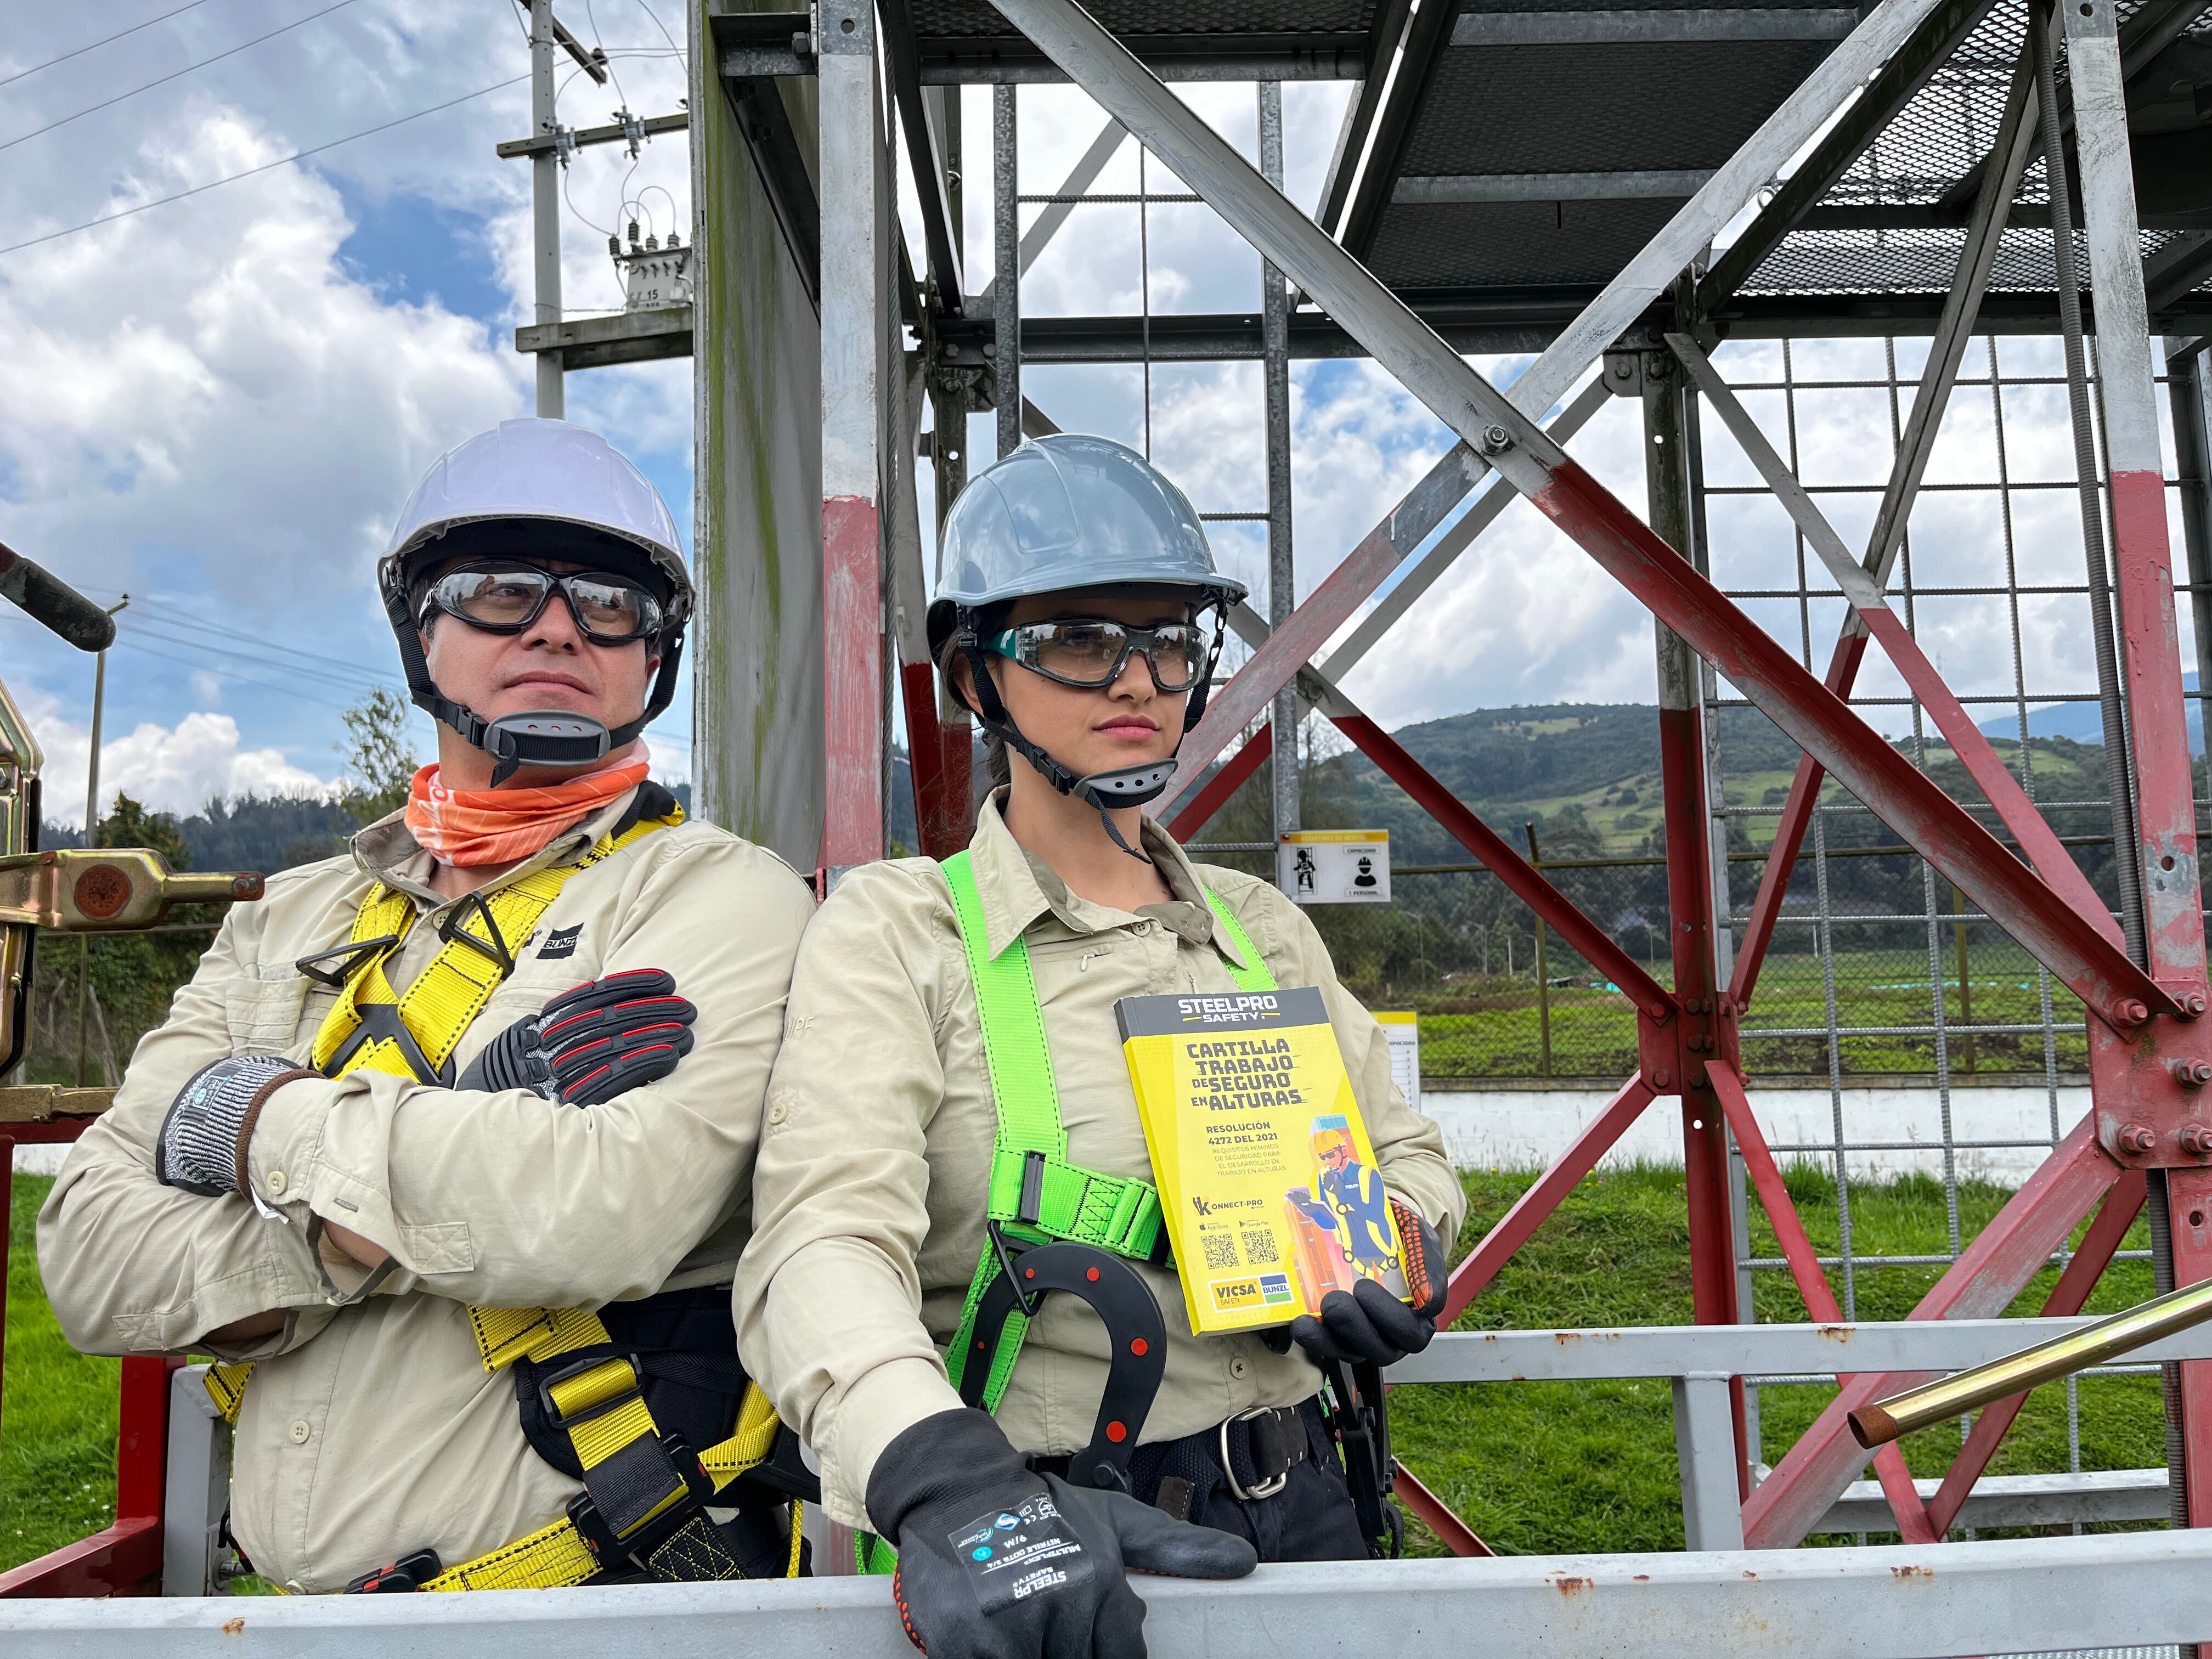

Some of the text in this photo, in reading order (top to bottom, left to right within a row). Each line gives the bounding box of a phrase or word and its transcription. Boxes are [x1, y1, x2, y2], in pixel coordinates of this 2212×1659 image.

[647, 289, 658, 300] 15
[543, 935, 577, 948] BUNZ
[1178, 995, 1278, 1014] STEELPRO
[1187, 1038, 1290, 1058] CARTILLA
[1195, 1055, 1294, 1076] TRABAJO
[1192, 1072, 1291, 1093] DE SEGURO
[1191, 1088, 1302, 1111] EN ALTURAS
[1206, 1120, 1271, 1133] RESOLUCIÓN
[1208, 1132, 1278, 1145] 4272 DEL 2021
[1212, 1146, 1250, 1154] REQUISITOS
[1225, 1153, 1262, 1161] SEGURIDAD
[1228, 1159, 1270, 1169] DESARROLLO
[1216, 1284, 1257, 1298] VICSA
[1263, 1284, 1289, 1294] BUNZL
[1026, 1537, 1061, 1553] NITRILE
[1014, 1571, 1066, 1599] STEELPR
